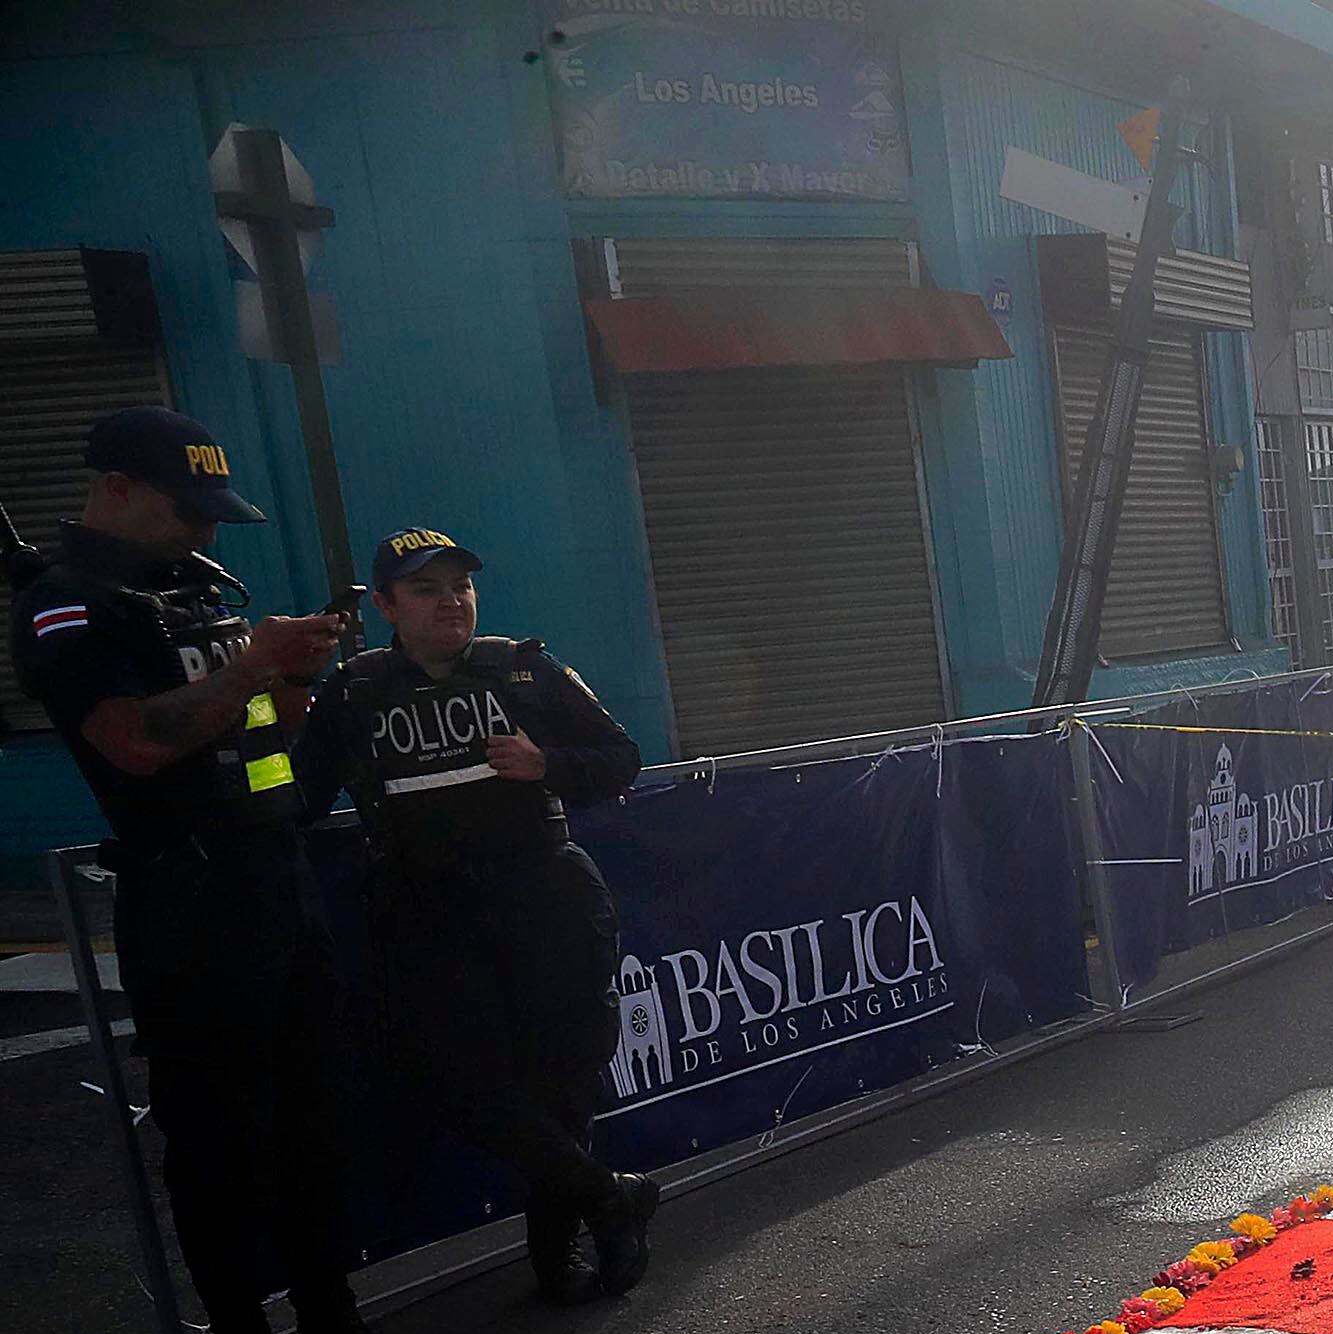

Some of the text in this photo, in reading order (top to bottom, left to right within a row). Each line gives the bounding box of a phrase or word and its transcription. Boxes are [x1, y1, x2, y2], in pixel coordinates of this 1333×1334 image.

[634, 71, 819, 114] Los Angeles
[371, 689, 512, 760] POLICIA
[661, 894, 946, 1044] BASILICA
[680, 971, 950, 1074] DE LOS ANGELES
